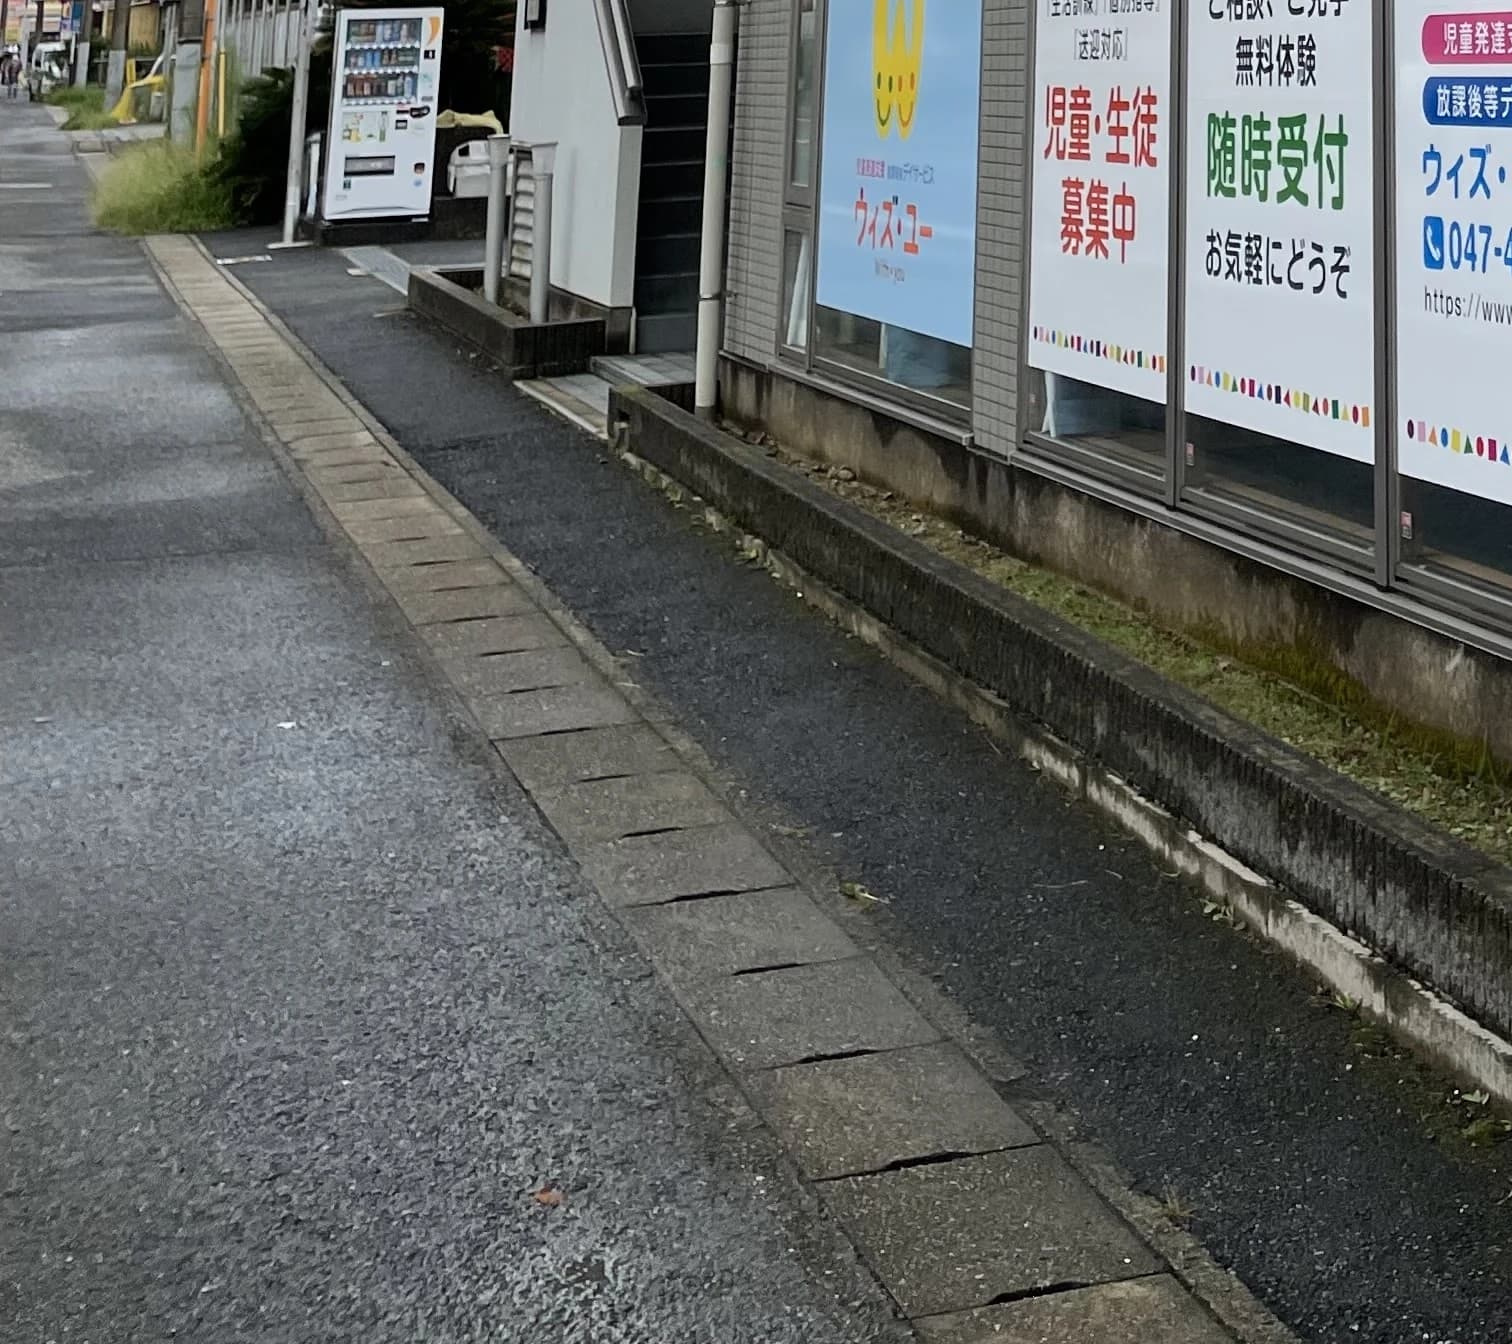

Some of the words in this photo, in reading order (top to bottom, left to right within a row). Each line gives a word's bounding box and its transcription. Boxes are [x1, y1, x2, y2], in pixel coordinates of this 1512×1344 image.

[1235, 35, 1317, 88] 無料体験
[1044, 85, 1159, 169] 児童・生徒
[1206, 111, 1349, 212] 随時受付
[855, 186, 933, 255] ウィズ・ユー
[1061, 178, 1137, 264] 募集中
[1205, 229, 1352, 301] お気軽にどうぞ
